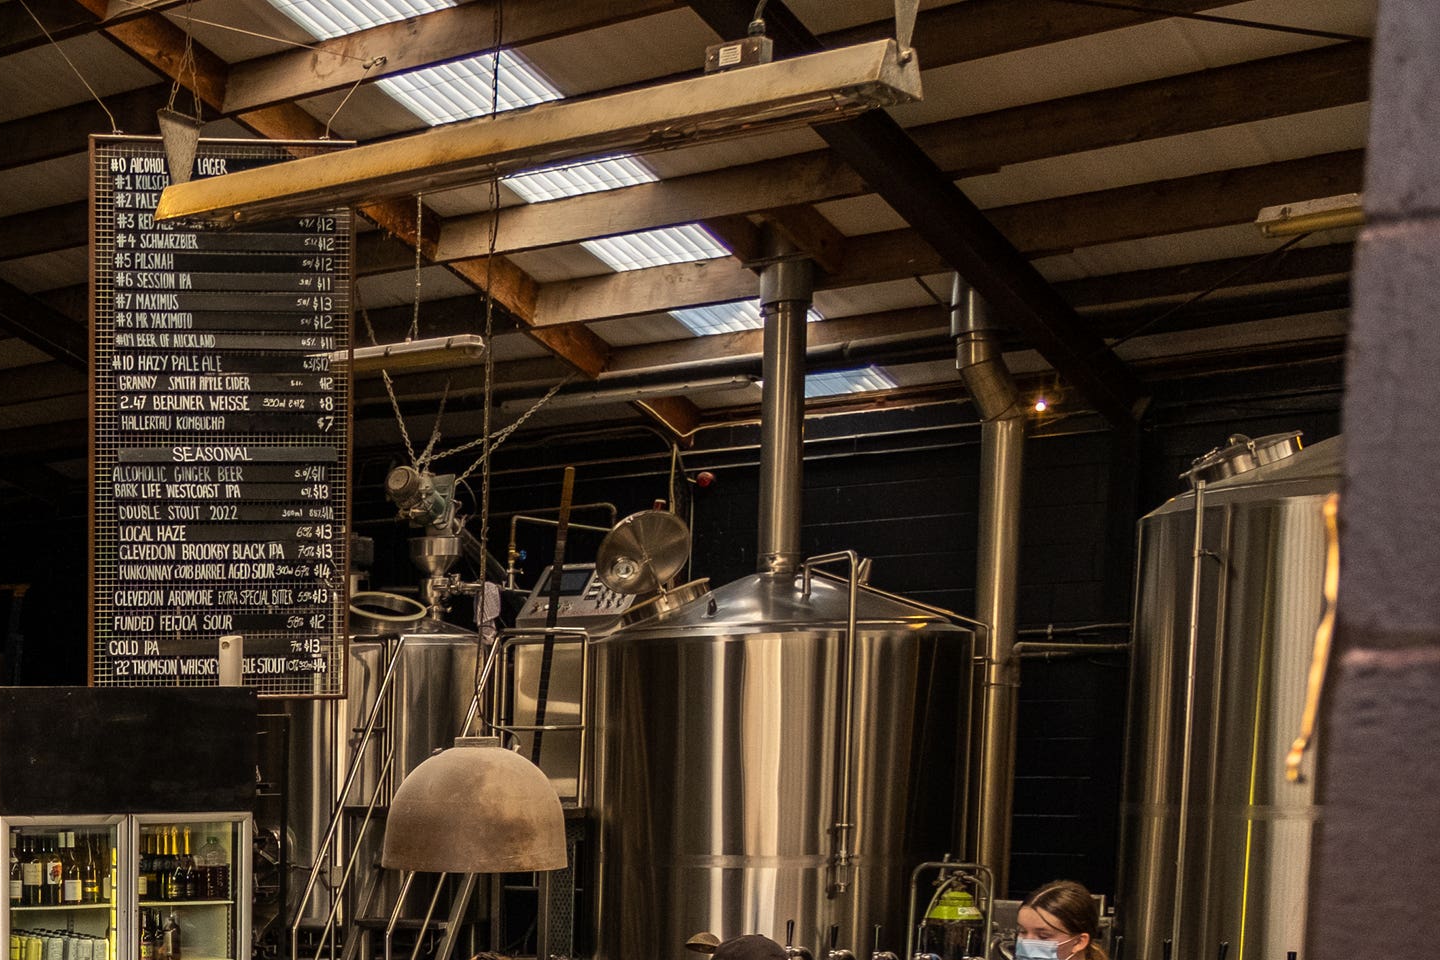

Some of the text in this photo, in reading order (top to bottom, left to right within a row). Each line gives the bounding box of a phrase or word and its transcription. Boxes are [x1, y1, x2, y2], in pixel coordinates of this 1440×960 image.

[111, 157, 228, 175] #0 ALCOHOL LAGER
[115, 174, 132, 190] #1
[116, 192, 158, 209] #2 PALE
[117, 213, 134, 229] #3
[138, 213, 154, 230] RED
[316, 217, 334, 232] $12
[116, 233, 136, 248] #4
[140, 233, 198, 249] SCHWARZBIER
[318, 236, 335, 251] $12
[114, 253, 132, 268] #5
[135, 253, 174, 270] PILSNAH
[314, 257, 333, 271] $12
[116, 272, 133, 287] #6
[137, 272, 175, 289] SESSION
[179, 273, 192, 289] IPA
[317, 276, 331, 291] $11
[115, 293, 132, 309] #7
[136, 293, 179, 310] MAXIMUS
[312, 296, 332, 311] $13
[116, 312, 133, 328] #8
[136, 313, 149, 328] MR
[150, 312, 193, 329] YAKIMOTO
[314, 315, 333, 330] $12
[115, 333, 134, 346] #09
[136, 333, 158, 347] BEER
[160, 333, 169, 347] OF
[173, 334, 216, 348] AUCKLAND
[320, 336, 333, 350] $11
[112, 355, 134, 370] #10
[138, 355, 168, 370] HAZY
[171, 355, 200, 371] PALE
[202, 355, 222, 372] ALE
[119, 375, 158, 391] GRANNY
[168, 376, 196, 390] SMITH
[200, 376, 223, 391] APPLE
[225, 376, 251, 391] CIDER
[120, 395, 147, 410] 2.47
[153, 395, 205, 411] BERLINER
[209, 395, 250, 411] WEISSE
[320, 396, 334, 411] $8
[121, 415, 334, 432] HALLERTAU KOMBUCHA $7
[172, 446, 253, 462] SEASONAL
[113, 466, 167, 482] ALCOHOLIC
[174, 465, 212, 482] GINGER
[218, 466, 244, 482] BEER
[312, 465, 325, 481] $11
[114, 484, 138, 498] BARK
[141, 483, 162, 499] LIFE
[166, 483, 220, 499] WESTCOAST
[225, 484, 241, 498] IPA
[313, 484, 329, 499] $13
[119, 505, 162, 520] DOUBLE
[168, 505, 201, 520] STOUT
[209, 505, 238, 520] 2022
[119, 525, 154, 541] LOCAL
[157, 525, 186, 541] HAZE
[315, 523, 333, 539] $13
[119, 543, 176, 560] CLEVEDON
[182, 543, 229, 560] BROOKBY
[232, 543, 266, 560] BLACK
[269, 543, 285, 560] IPA
[315, 543, 333, 559] $13
[119, 564, 172, 580] FUNKONNAY
[174, 564, 194, 579] 2018
[194, 564, 226, 580] BARREL
[228, 563, 251, 580] AGED
[251, 563, 276, 580] SOUR
[313, 563, 331, 579] $14
[114, 590, 164, 606] CLEVEDON
[167, 590, 213, 606] ARDMORE
[217, 590, 238, 605] EXTRA
[239, 589, 269, 605] SPECIAL
[312, 588, 328, 604] $13
[114, 615, 154, 631] FUNDED
[160, 615, 198, 631] FEIJOA
[203, 614, 233, 630] SOUR
[309, 614, 326, 629] $12
[144, 641, 160, 656] IPA
[303, 639, 320, 653] $13
[132, 659, 177, 676] THOMSON
[257, 657, 286, 674] STOUT
